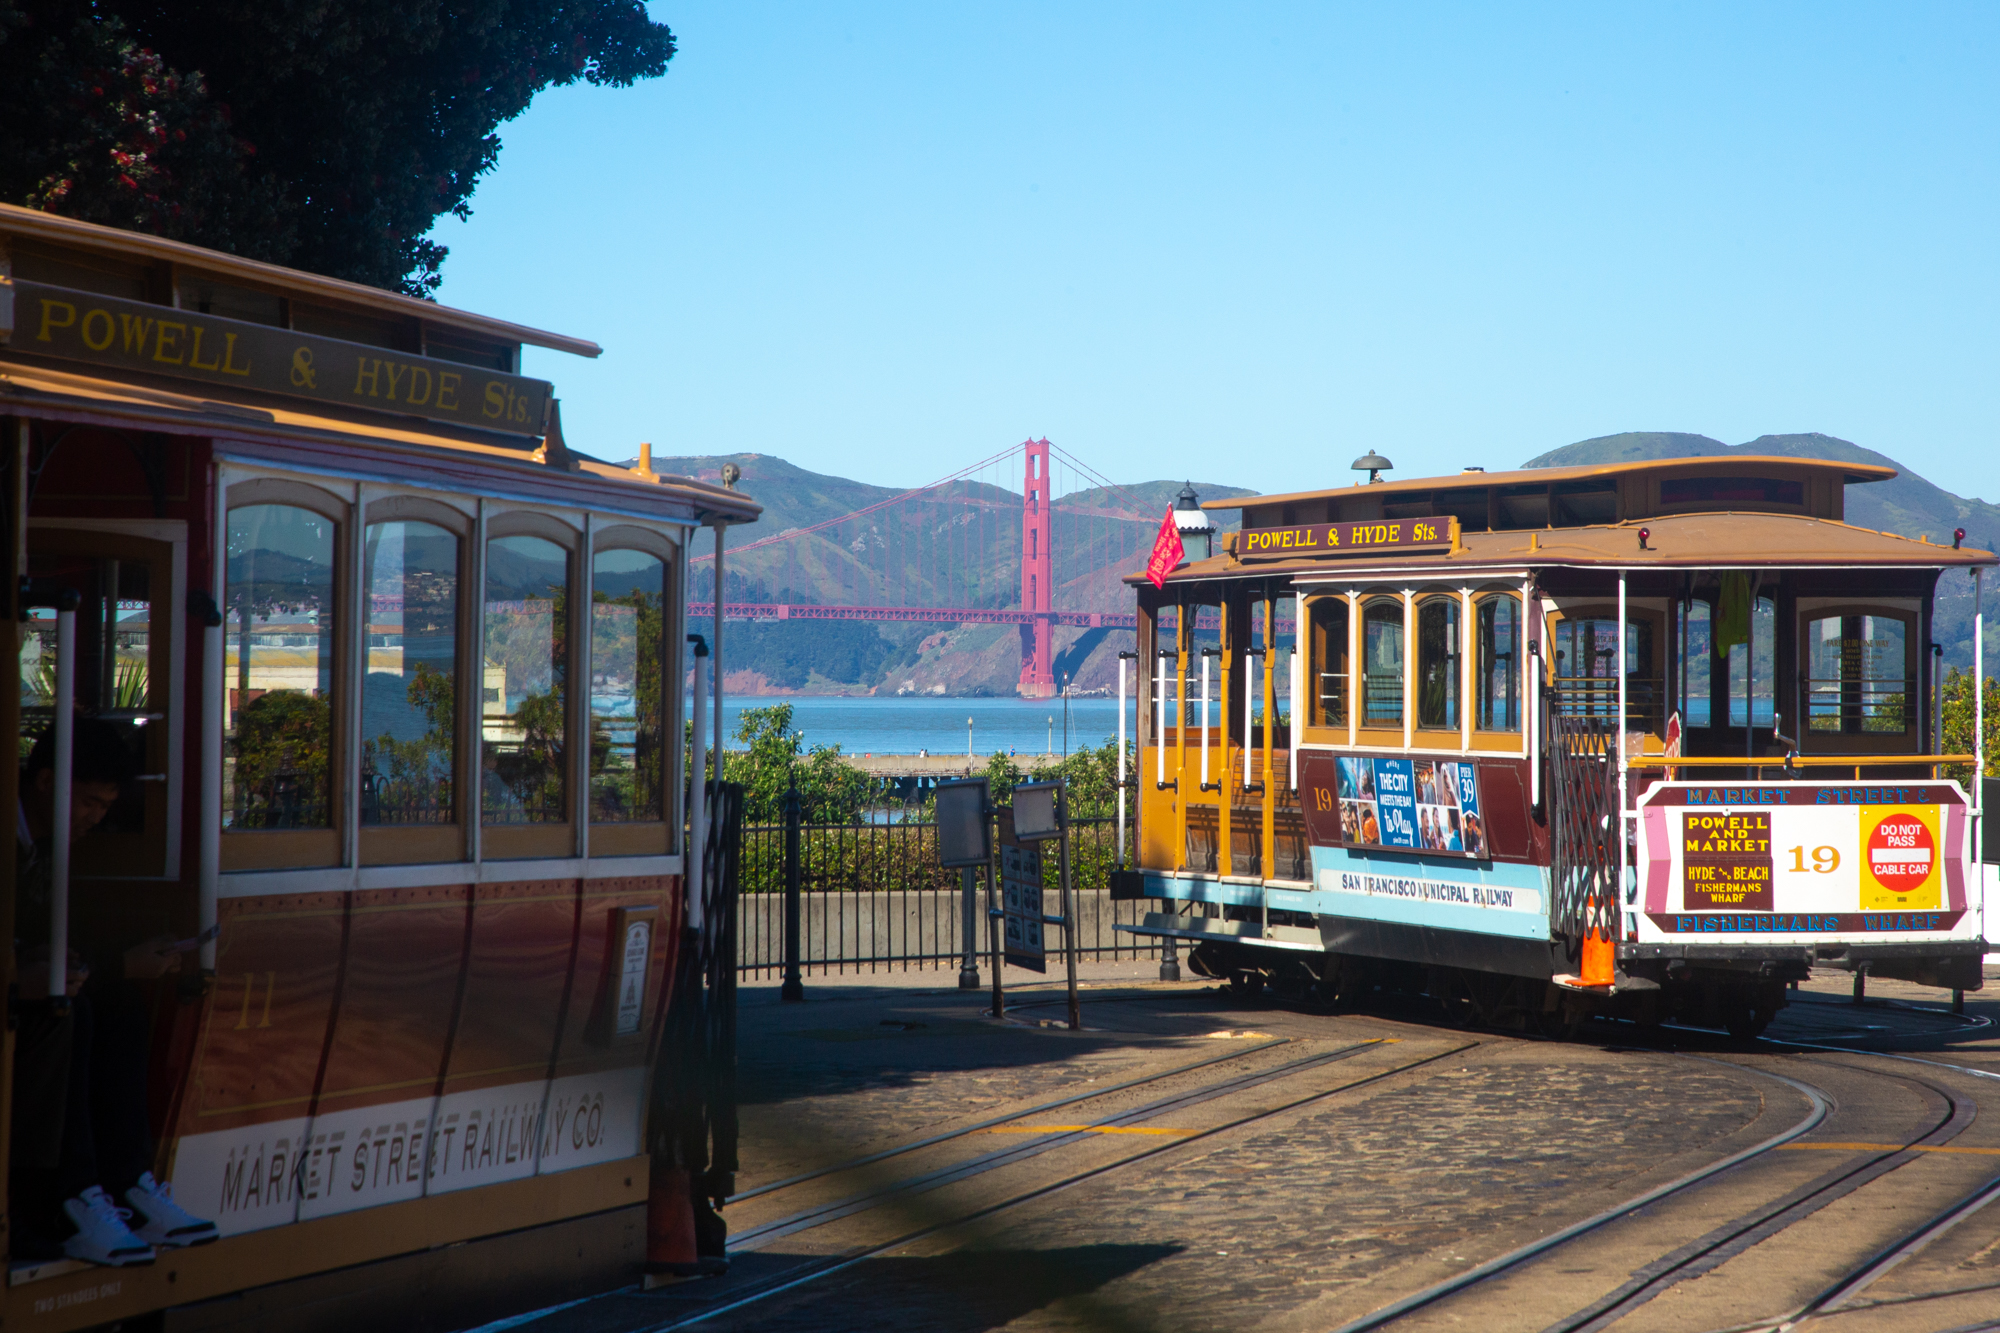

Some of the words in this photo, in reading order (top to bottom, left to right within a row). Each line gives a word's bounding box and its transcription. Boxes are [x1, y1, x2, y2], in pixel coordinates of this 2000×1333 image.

[36, 299, 251, 377] POWELL
[289, 347, 317, 390] &
[353, 357, 462, 411] HYDE
[482, 381, 532, 424] Sts.
[1247, 530, 1317, 550] POWELL
[1327, 528, 1340, 546] &
[1352, 525, 1400, 544] HYDE
[1413, 523, 1438, 542] Sts.
[1826, 639, 1842, 648] FARE
[1860, 639, 1873, 648] ONE
[1875, 639, 1889, 648] WAY
[1379, 773, 1393, 791] THE
[1393, 773, 1408, 791] CITY
[1461, 779, 1474, 803] 39
[1687, 788, 1790, 804] MARKET
[1816, 787, 1909, 804] STREET
[1313, 787, 1332, 812] 19
[1380, 794, 1394, 806] MEETS
[1394, 795, 1403, 807] THE
[1403, 796, 1412, 807] BAY
[1384, 808, 1395, 833] to
[1393, 808, 1414, 847] Play
[1688, 816, 1768, 829] POWELL
[1881, 824, 1897, 835] DO
[1899, 824, 1922, 835] NOT
[1709, 829, 1748, 839] AND
[1888, 836, 1915, 847] PASS
[1686, 839, 1769, 852] MARKET
[1788, 845, 1841, 873] 19
[1688, 866, 1716, 880] HYDE
[1733, 866, 1769, 880] BEACH
[1874, 864, 1906, 875] CABLE
[1908, 864, 1928, 874] CAR
[1342, 873, 1361, 890] SAN
[1695, 882, 1762, 892] FISHERMANS
[1711, 893, 1745, 902] WHARF
[1676, 914, 1839, 932] FISHERMANS
[1864, 914, 1941, 931] WHARF
[219, 1143, 342, 1214] MARKET
[350, 1126, 455, 1193] STREET
[461, 1108, 568, 1172] RAILWAY
